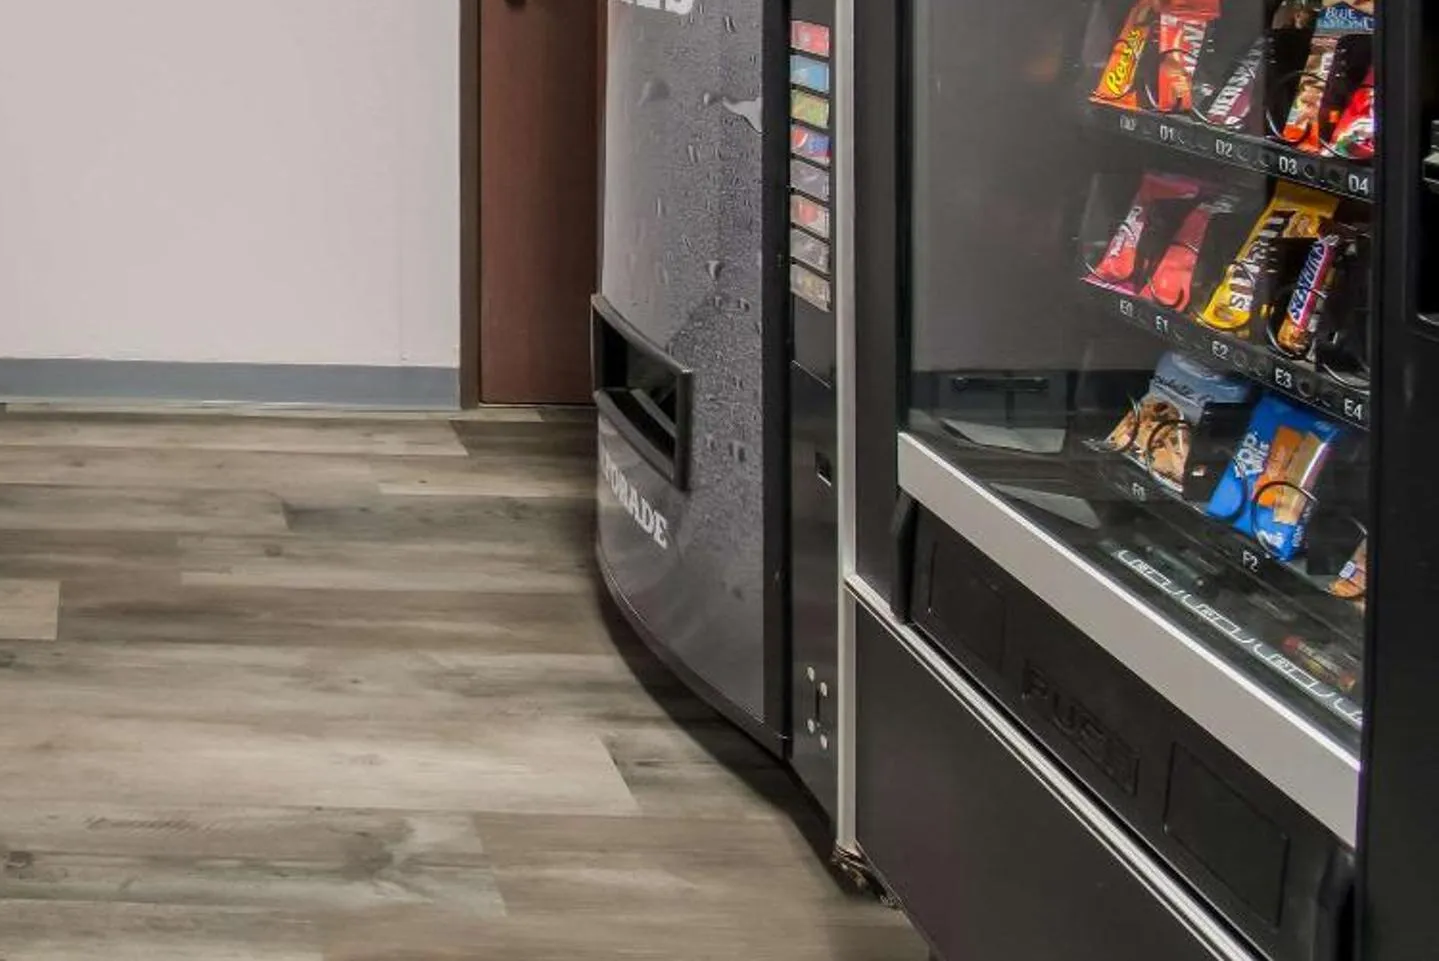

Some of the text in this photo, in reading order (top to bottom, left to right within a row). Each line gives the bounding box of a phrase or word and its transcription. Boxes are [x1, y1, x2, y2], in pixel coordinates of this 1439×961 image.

[1212, 341, 1229, 361] E2
[1275, 368, 1293, 390] E3
[1344, 398, 1362, 421] E4
